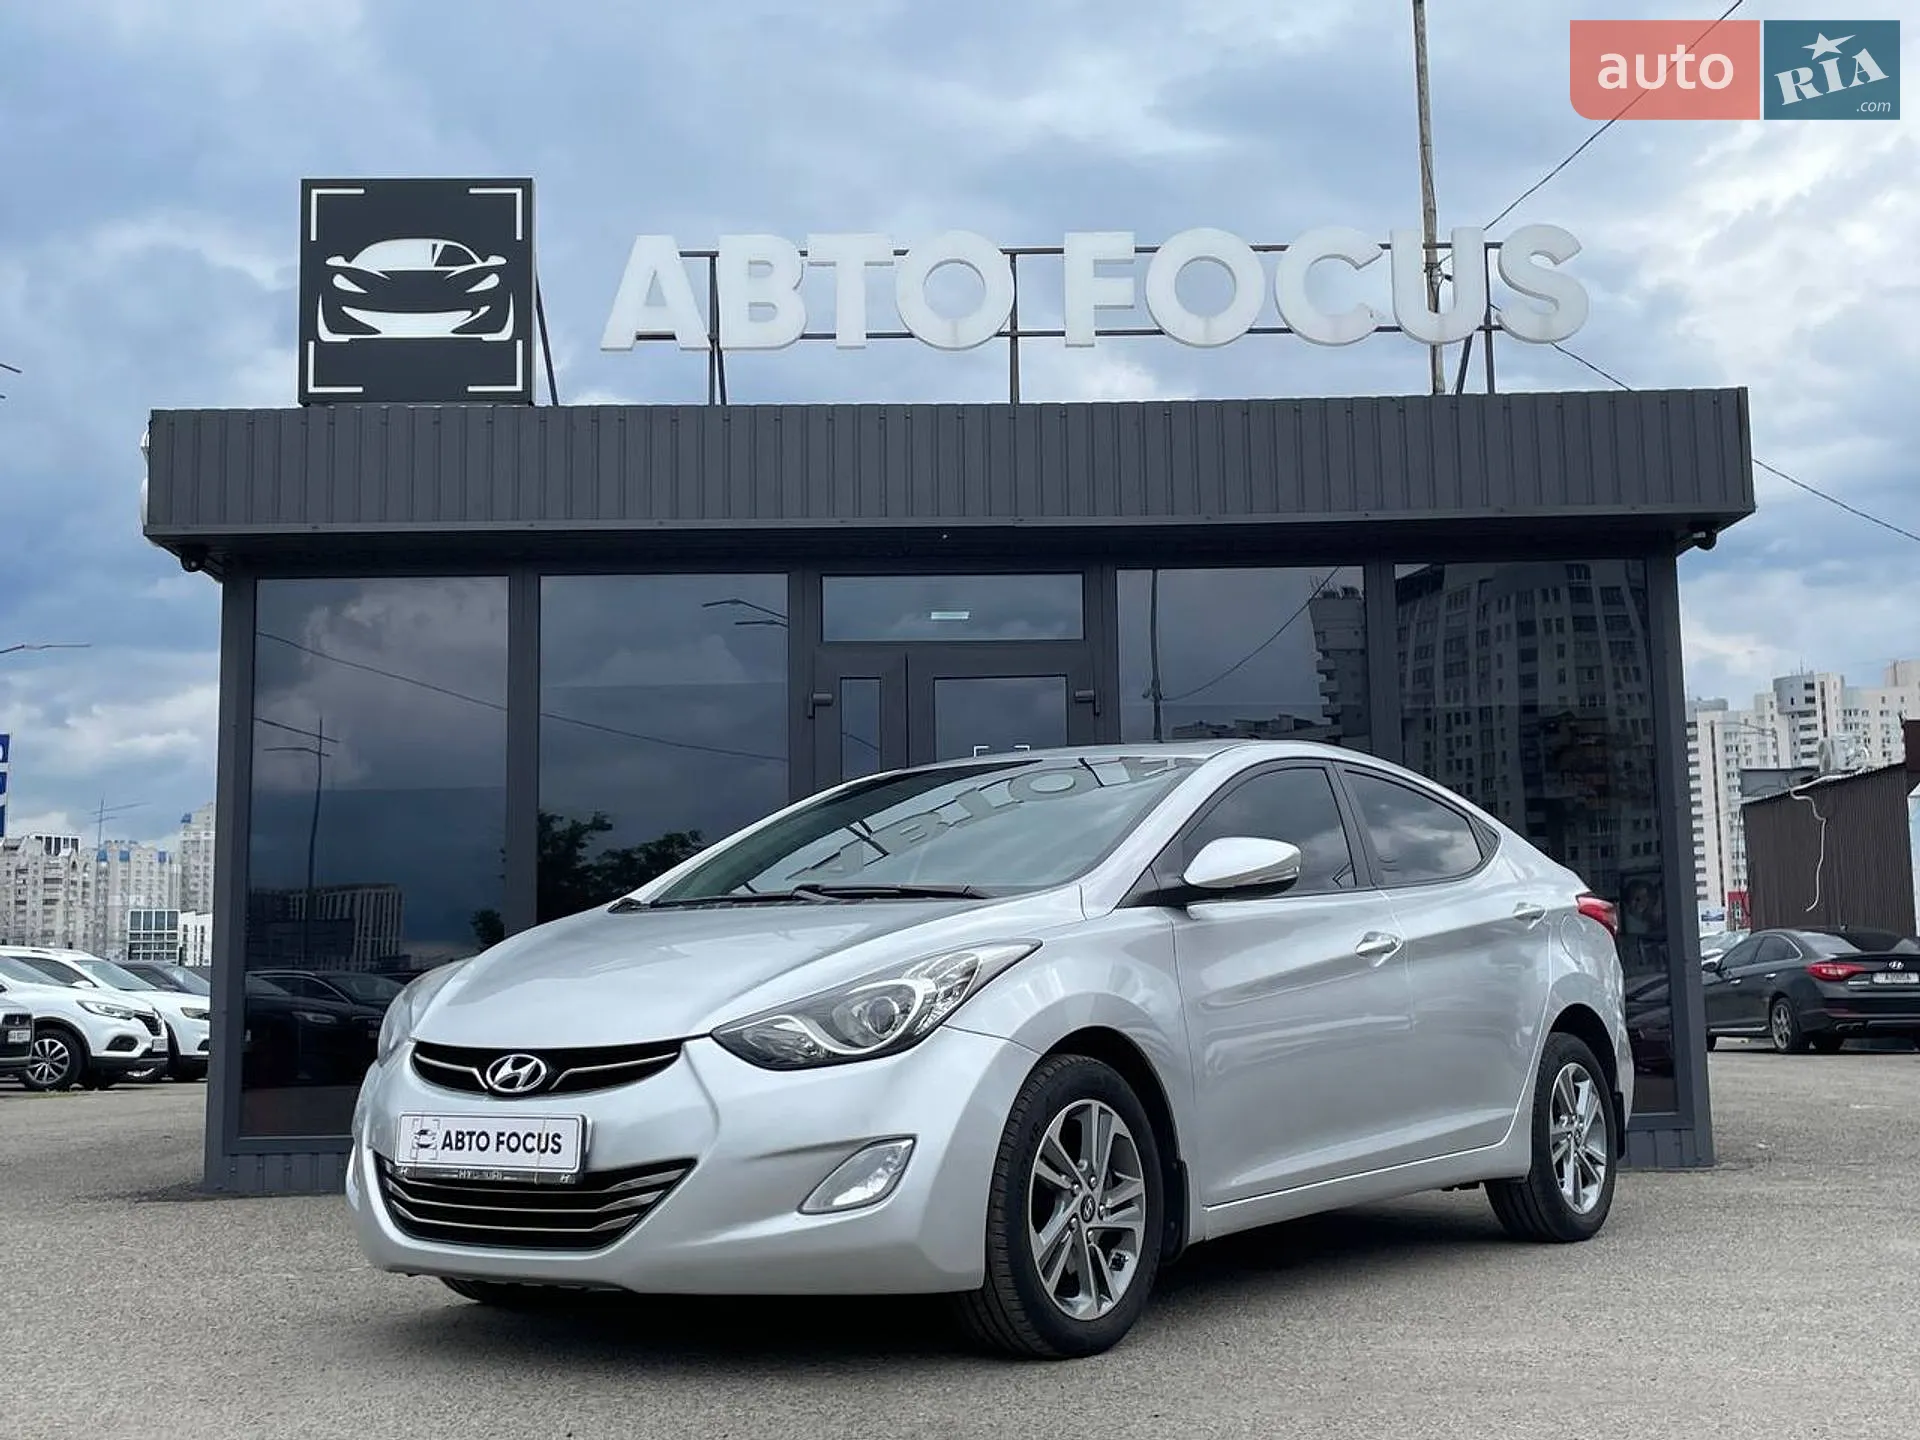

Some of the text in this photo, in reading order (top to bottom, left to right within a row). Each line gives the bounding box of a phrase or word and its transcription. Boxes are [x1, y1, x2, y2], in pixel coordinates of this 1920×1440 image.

[600, 224, 1588, 350] АВТО FOCUS
[441, 1130, 562, 1154] АВТО FOCUS
